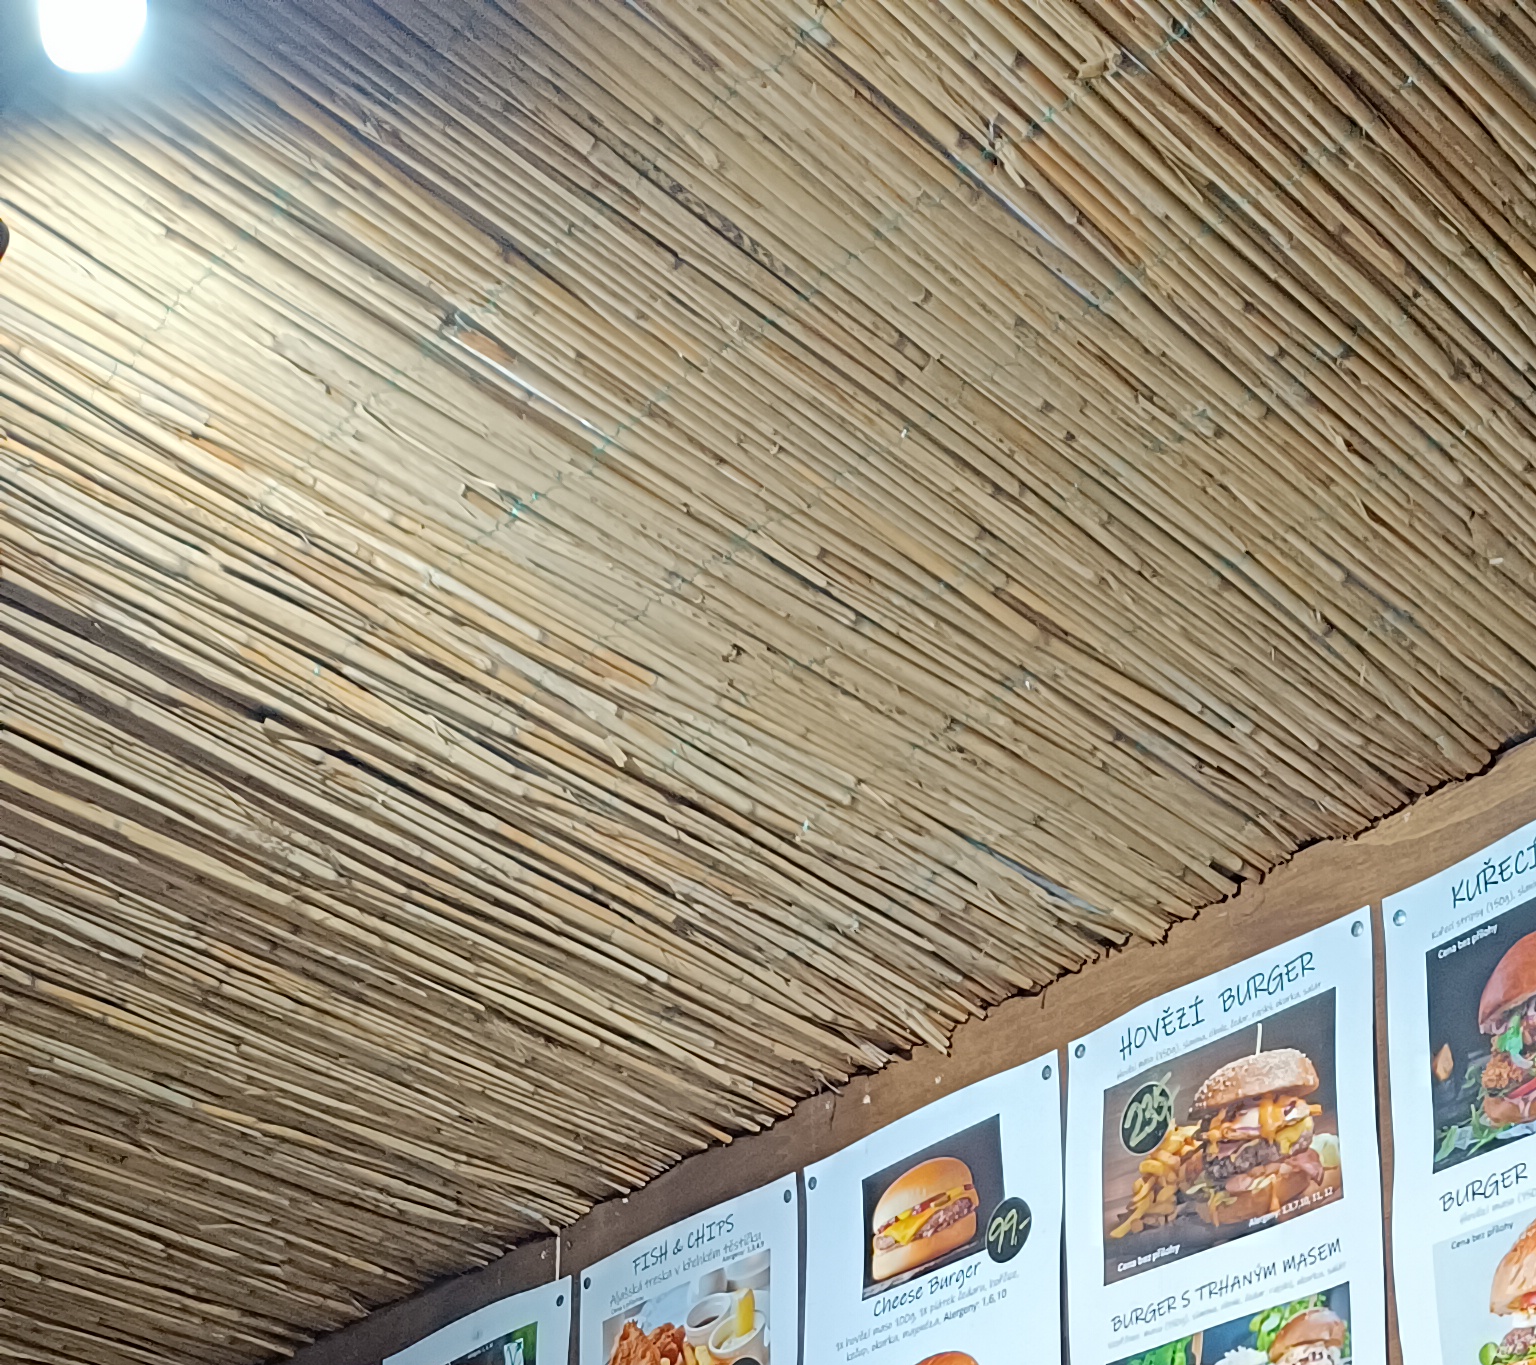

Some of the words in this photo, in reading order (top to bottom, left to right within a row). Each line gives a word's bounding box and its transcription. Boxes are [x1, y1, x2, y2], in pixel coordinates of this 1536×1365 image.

[1119, 996, 1205, 1061] HOVĚZÍ
[1219, 951, 1315, 1014] BURGER
[1439, 1161, 1528, 1213] BURGER
[632, 1240, 668, 1275] FISH
[673, 1239, 683, 1256] &
[687, 1213, 734, 1248] CHIPS
[873, 1284, 924, 1317] Cheese
[928, 1261, 982, 1292] Burger
[1110, 1294, 1178, 1333] BURGER
[1180, 1289, 1191, 1310] S
[1196, 1259, 1277, 1301] TRHANÝM
[1282, 1237, 1342, 1273] MASEM
